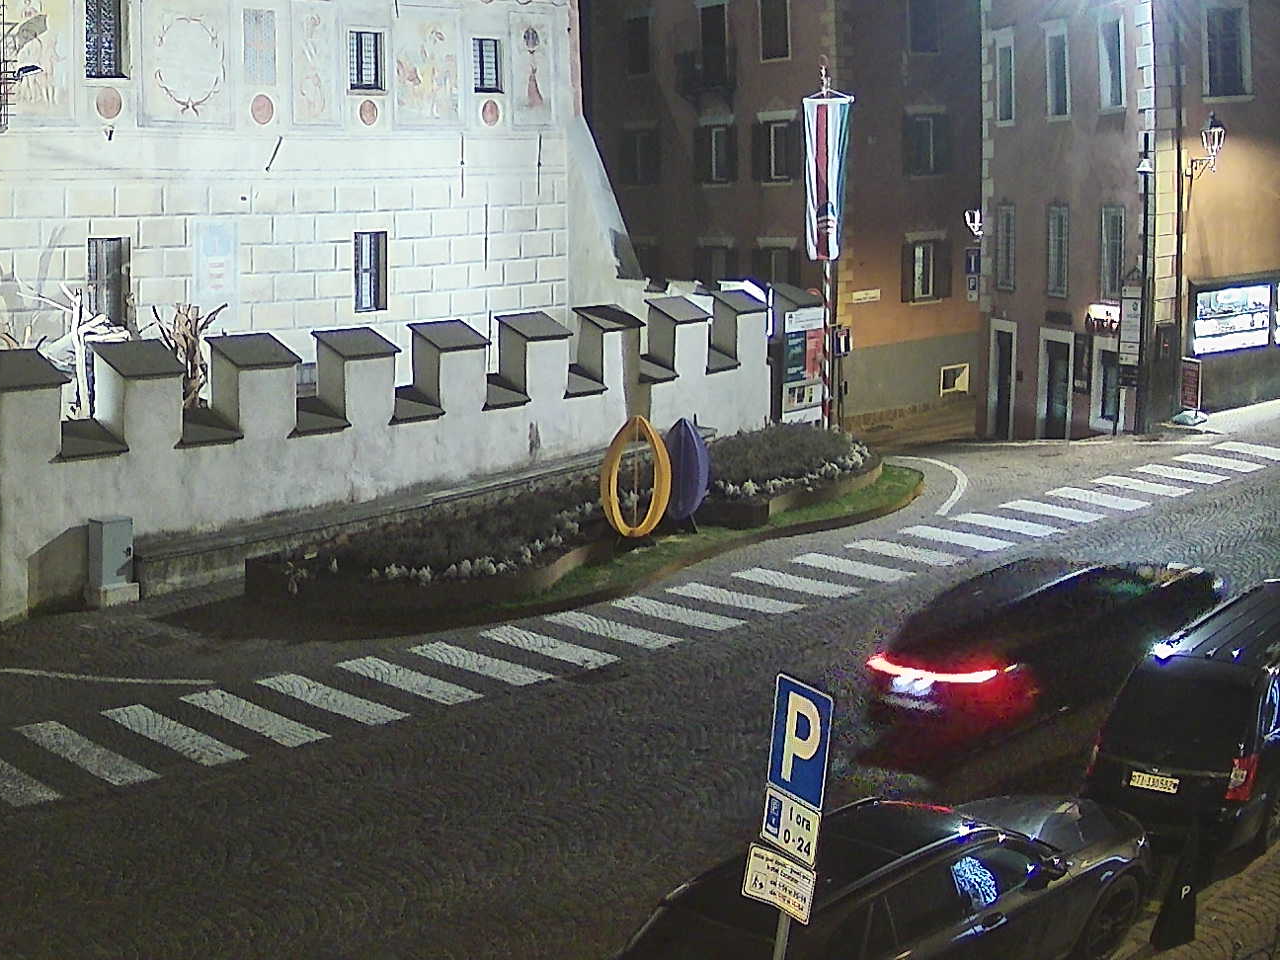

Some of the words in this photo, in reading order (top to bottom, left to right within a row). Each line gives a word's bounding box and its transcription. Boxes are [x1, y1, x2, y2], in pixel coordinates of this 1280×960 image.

[781, 691, 822, 782] P
[795, 814, 811, 832] ora
[1181, 885, 1191, 900] P
